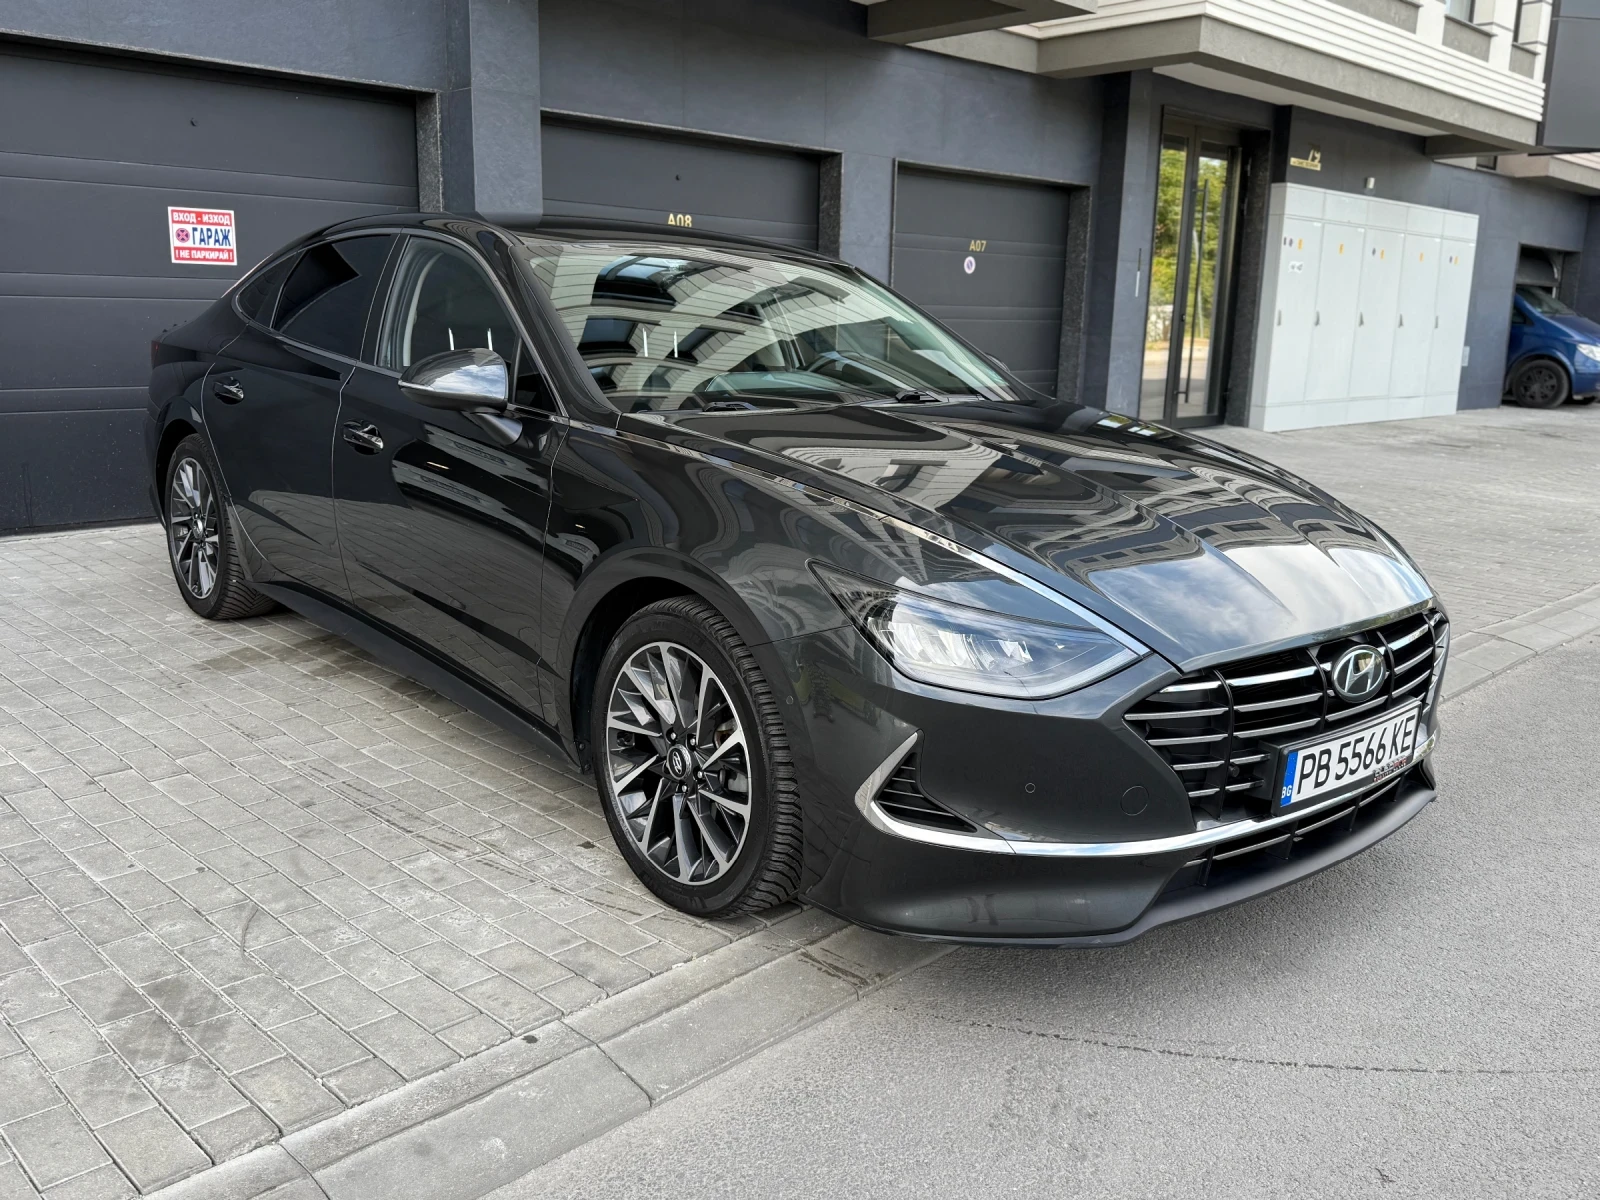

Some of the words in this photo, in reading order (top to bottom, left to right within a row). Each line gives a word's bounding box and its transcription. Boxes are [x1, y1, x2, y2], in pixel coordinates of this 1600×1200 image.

[172, 211, 197, 224] ВХОД
[202, 213, 231, 226] ИЗХОД
[667, 213, 692, 228] A08
[192, 227, 232, 247] ГАРАЖ
[969, 240, 987, 252] A07
[180, 249, 190, 259] НЕ
[191, 249, 229, 260] ПАРКИРАЙ
[1296, 748, 1332, 795] PB
[1334, 727, 1387, 781] 5566
[1388, 714, 1416, 760] KE
[1281, 784, 1293, 799] BG
